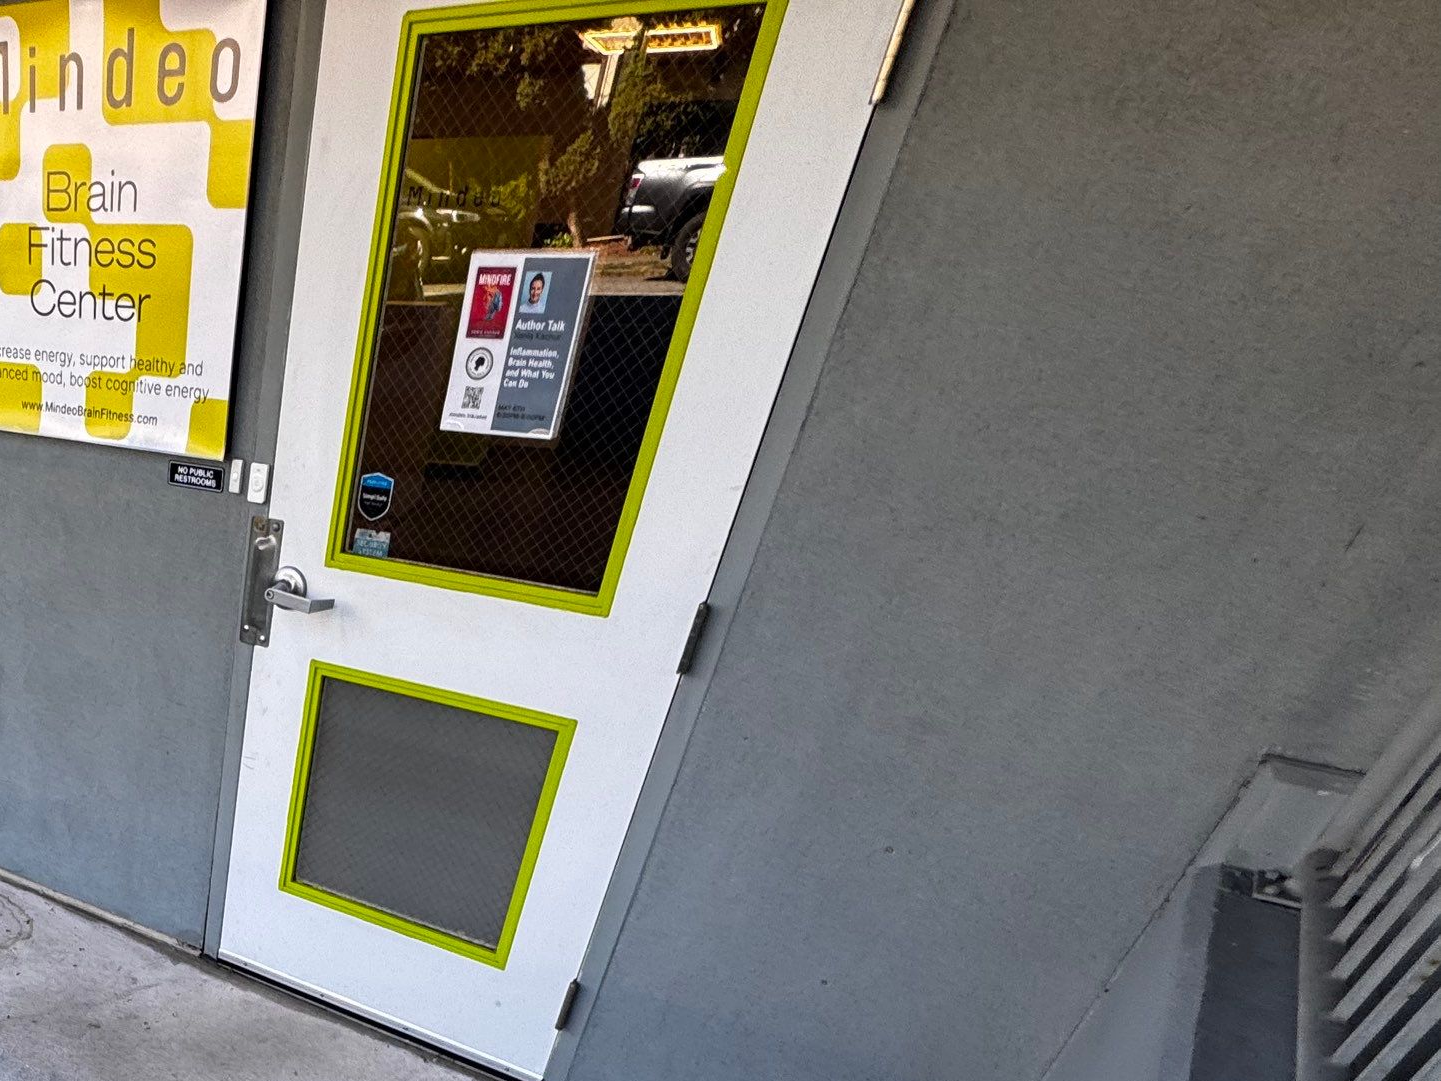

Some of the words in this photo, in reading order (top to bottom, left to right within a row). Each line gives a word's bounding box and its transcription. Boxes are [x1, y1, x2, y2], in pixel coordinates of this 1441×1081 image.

[46, 169, 138, 213] Brain
[27, 226, 157, 270] Fitness
[478, 273, 512, 286] MINDFIRE
[30, 279, 151, 323] Center
[515, 318, 546, 331] Author
[548, 319, 565, 332] Talk
[34, 349, 76, 368] energy,
[79, 352, 126, 373] support
[129, 355, 175, 378] healthy
[179, 361, 203, 377] and
[508, 357, 527, 367] Brain
[31, 370, 66, 388] mood,
[69, 372, 102, 390] boost
[105, 376, 161, 396] cognitive
[165, 384, 210, 404] energy
[21, 400, 159, 427] www.MindeoBrainFitness.com
[174, 473, 216, 488] RESTROOMS
[177, 465, 189, 475] NO
[189, 467, 214, 479] PUBLIC
